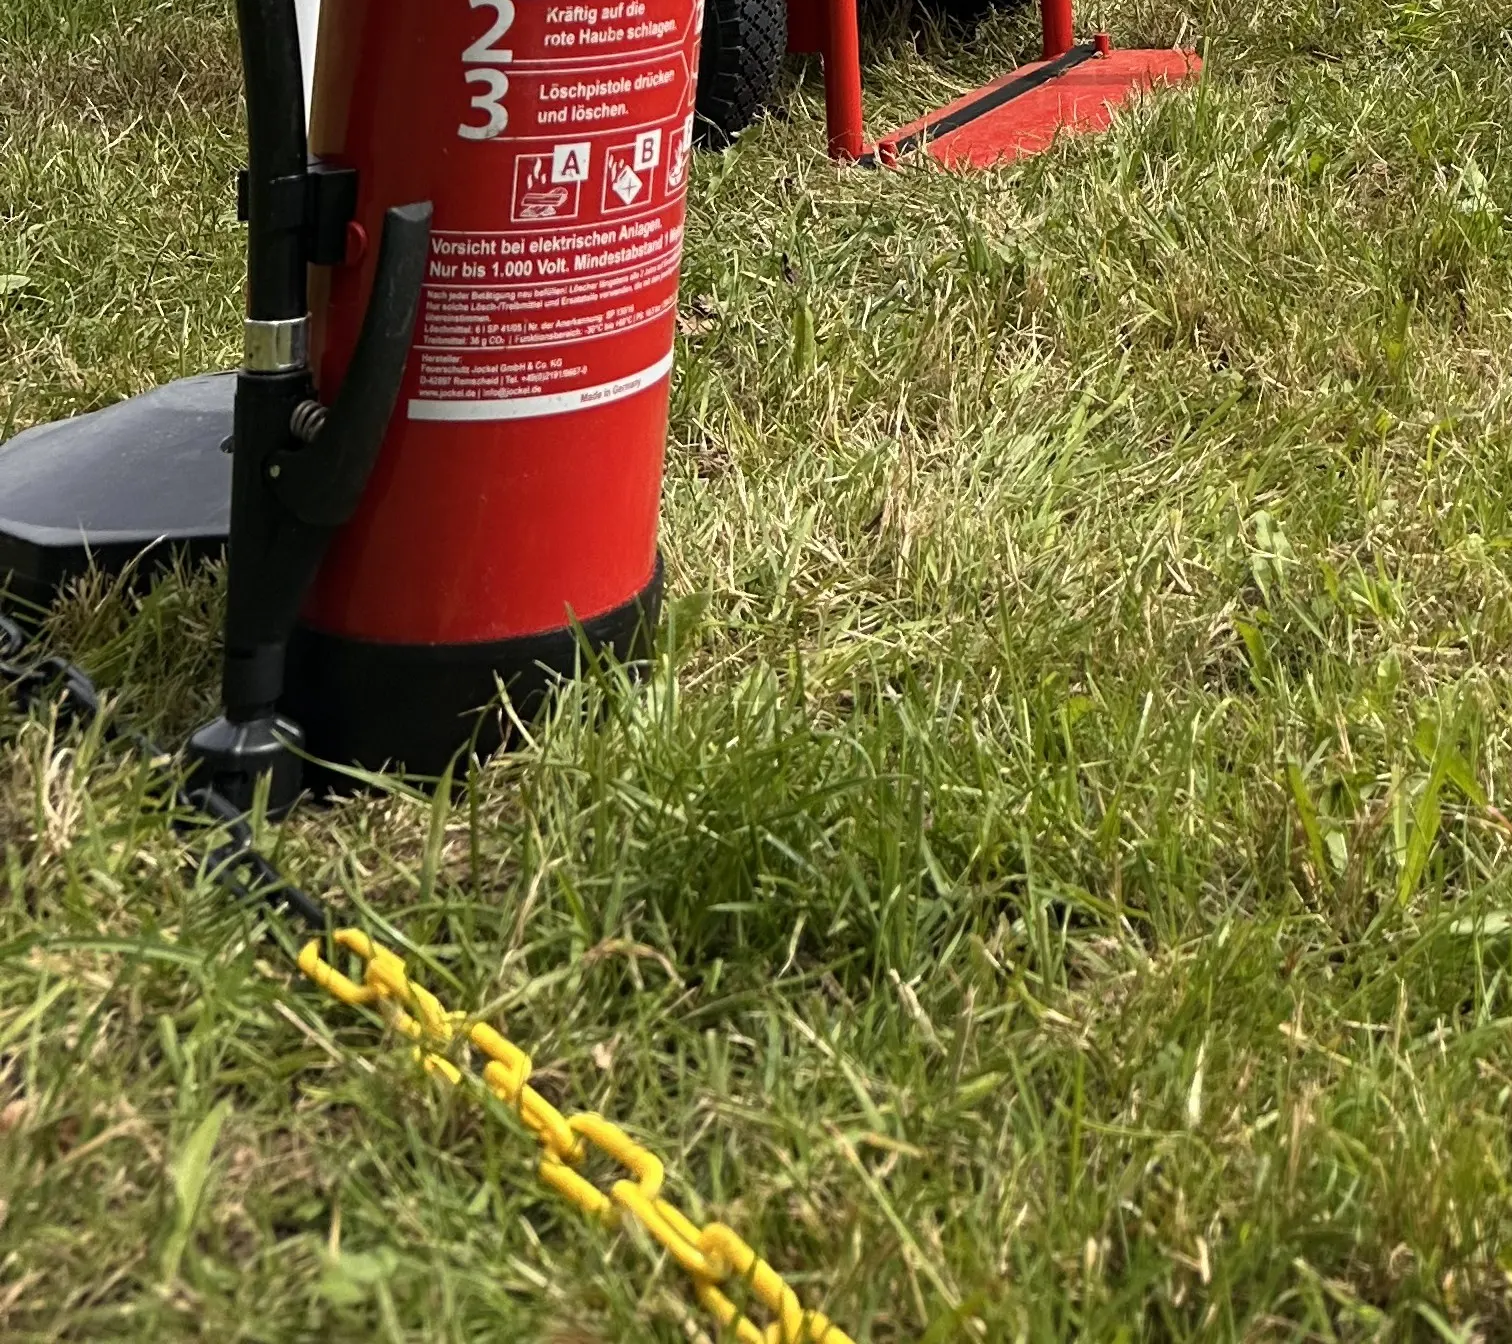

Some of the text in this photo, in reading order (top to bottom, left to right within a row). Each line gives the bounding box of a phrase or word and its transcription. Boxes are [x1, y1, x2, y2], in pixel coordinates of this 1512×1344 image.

[546, 0, 646, 25] Kräftig auf die
[544, 18, 677, 47] rote Haube schlagen.
[457, 67, 510, 142] 3
[539, 76, 632, 101] Löschpistole
[537, 102, 629, 123] und löschen.
[561, 136, 654, 176] A B
[431, 237, 497, 256] Vorsicht
[501, 237, 525, 255] bei
[529, 229, 616, 254] elektrischen
[618, 216, 662, 242] Anlagen.
[429, 261, 457, 278] Nur
[462, 261, 485, 278] bis
[492, 260, 532, 278] 1.000
[537, 257, 570, 276] Volt.
[574, 237, 663, 271] Mindestabstand
